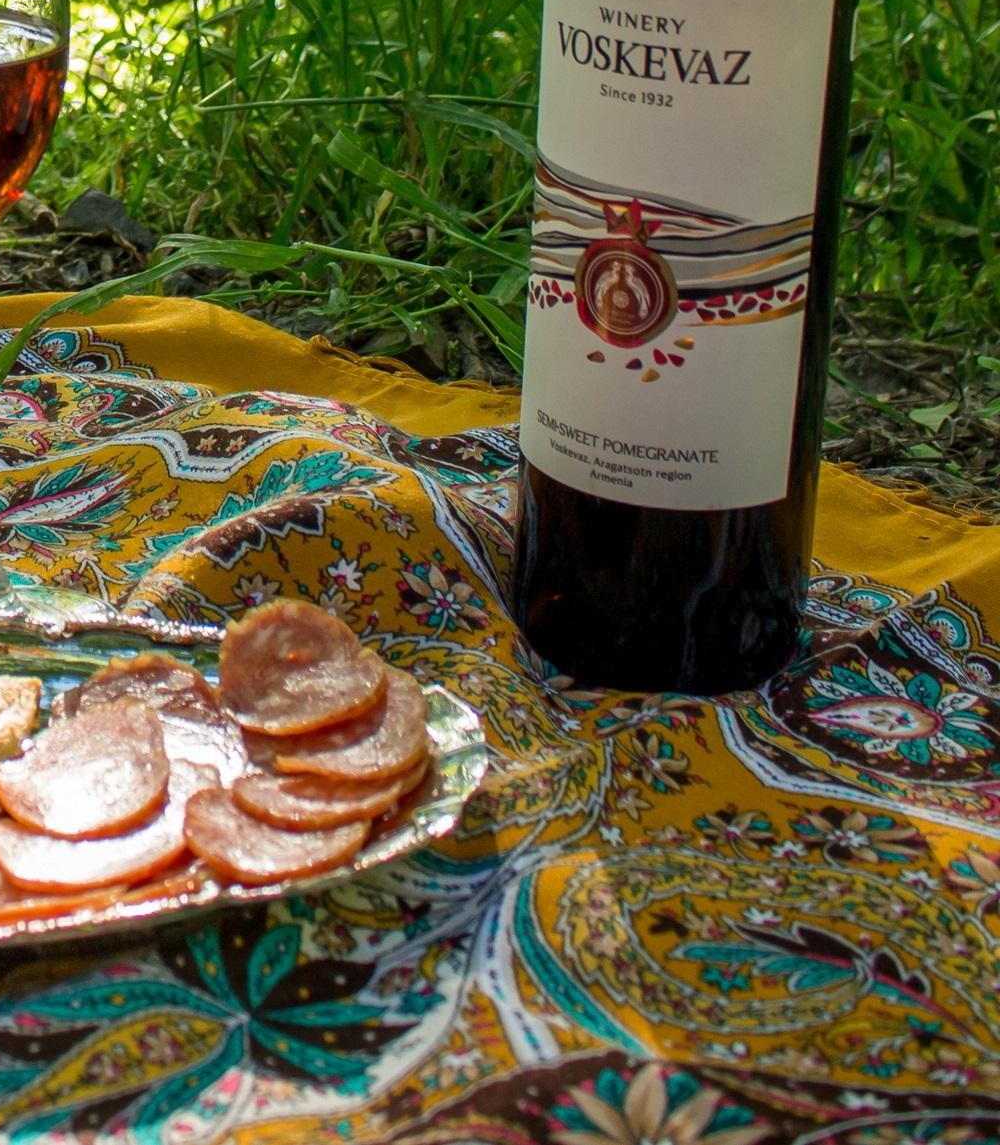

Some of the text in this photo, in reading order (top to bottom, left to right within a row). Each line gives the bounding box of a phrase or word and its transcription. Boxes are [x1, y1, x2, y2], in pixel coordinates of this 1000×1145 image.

[599, 6, 685, 35] WINERY
[558, 21, 751, 85] VOSKEVAZ
[600, 84, 673, 107] Since 1932
[537, 409, 720, 464] SEMI-SWEET POMEGRANATE
[590, 469, 633, 488] Armenia
[593, 457, 652, 477] Aragatsotn
[656, 471, 692, 482] region
